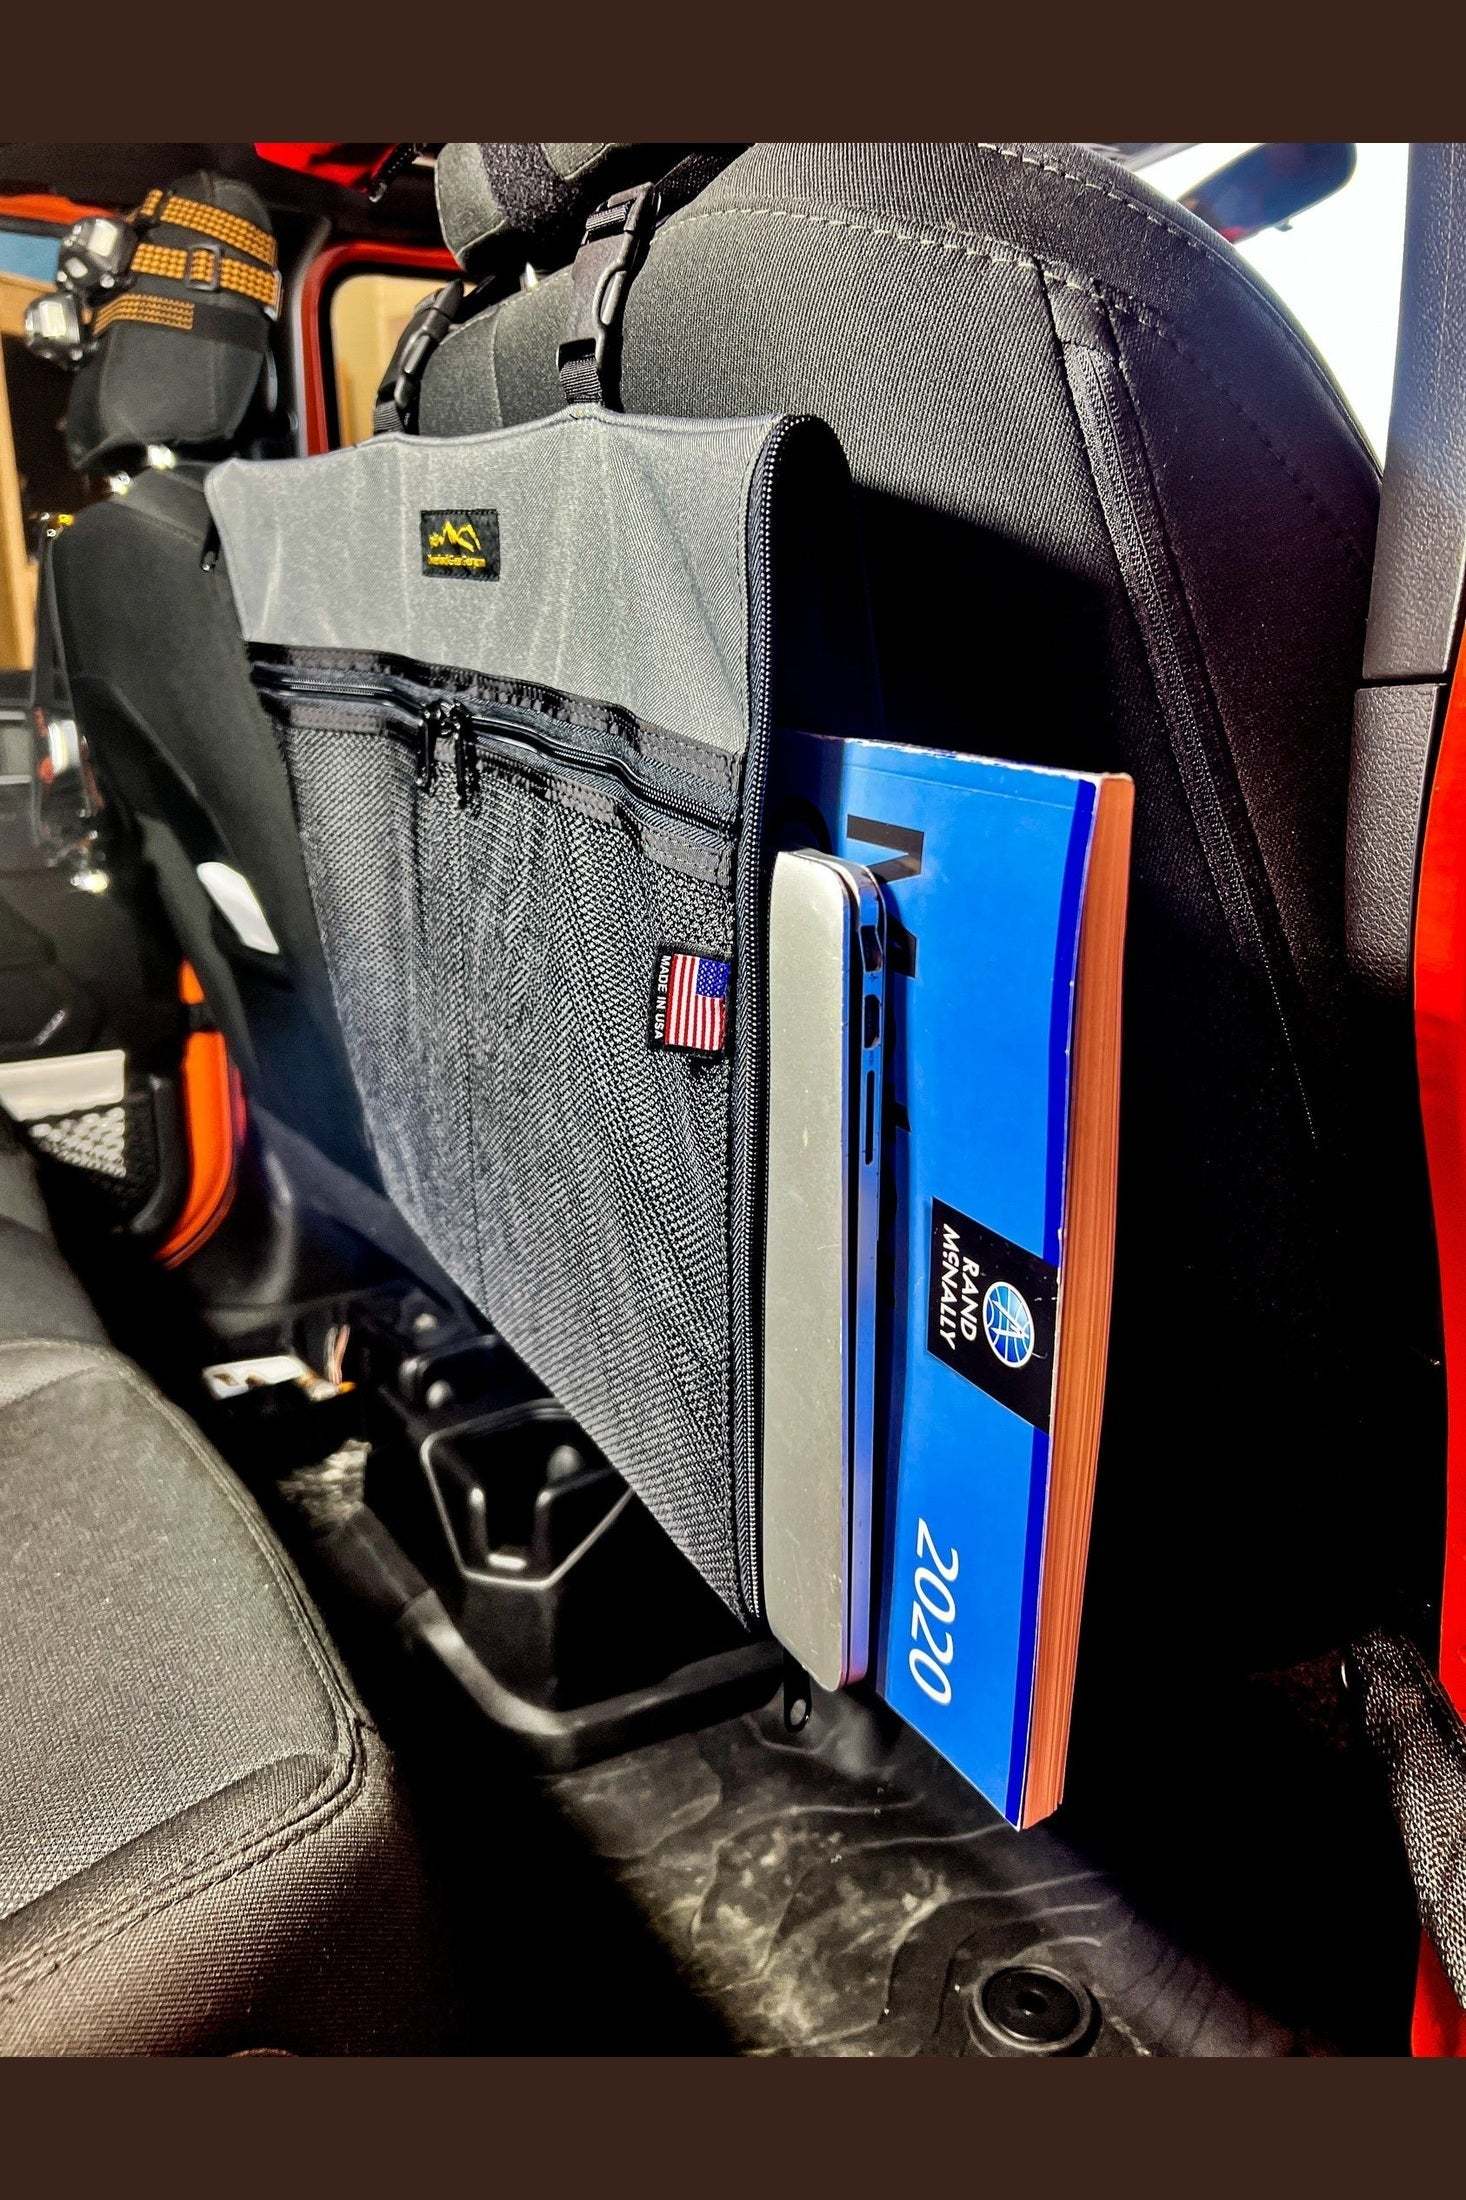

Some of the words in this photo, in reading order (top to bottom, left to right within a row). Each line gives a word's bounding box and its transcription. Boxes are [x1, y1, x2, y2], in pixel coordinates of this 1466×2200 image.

[658, 955, 672, 993] MADE
[656, 996, 667, 1010] IN
[654, 1013, 665, 1040] USA
[960, 1256, 980, 1342] RAND
[909, 1517, 959, 1706] 2020
